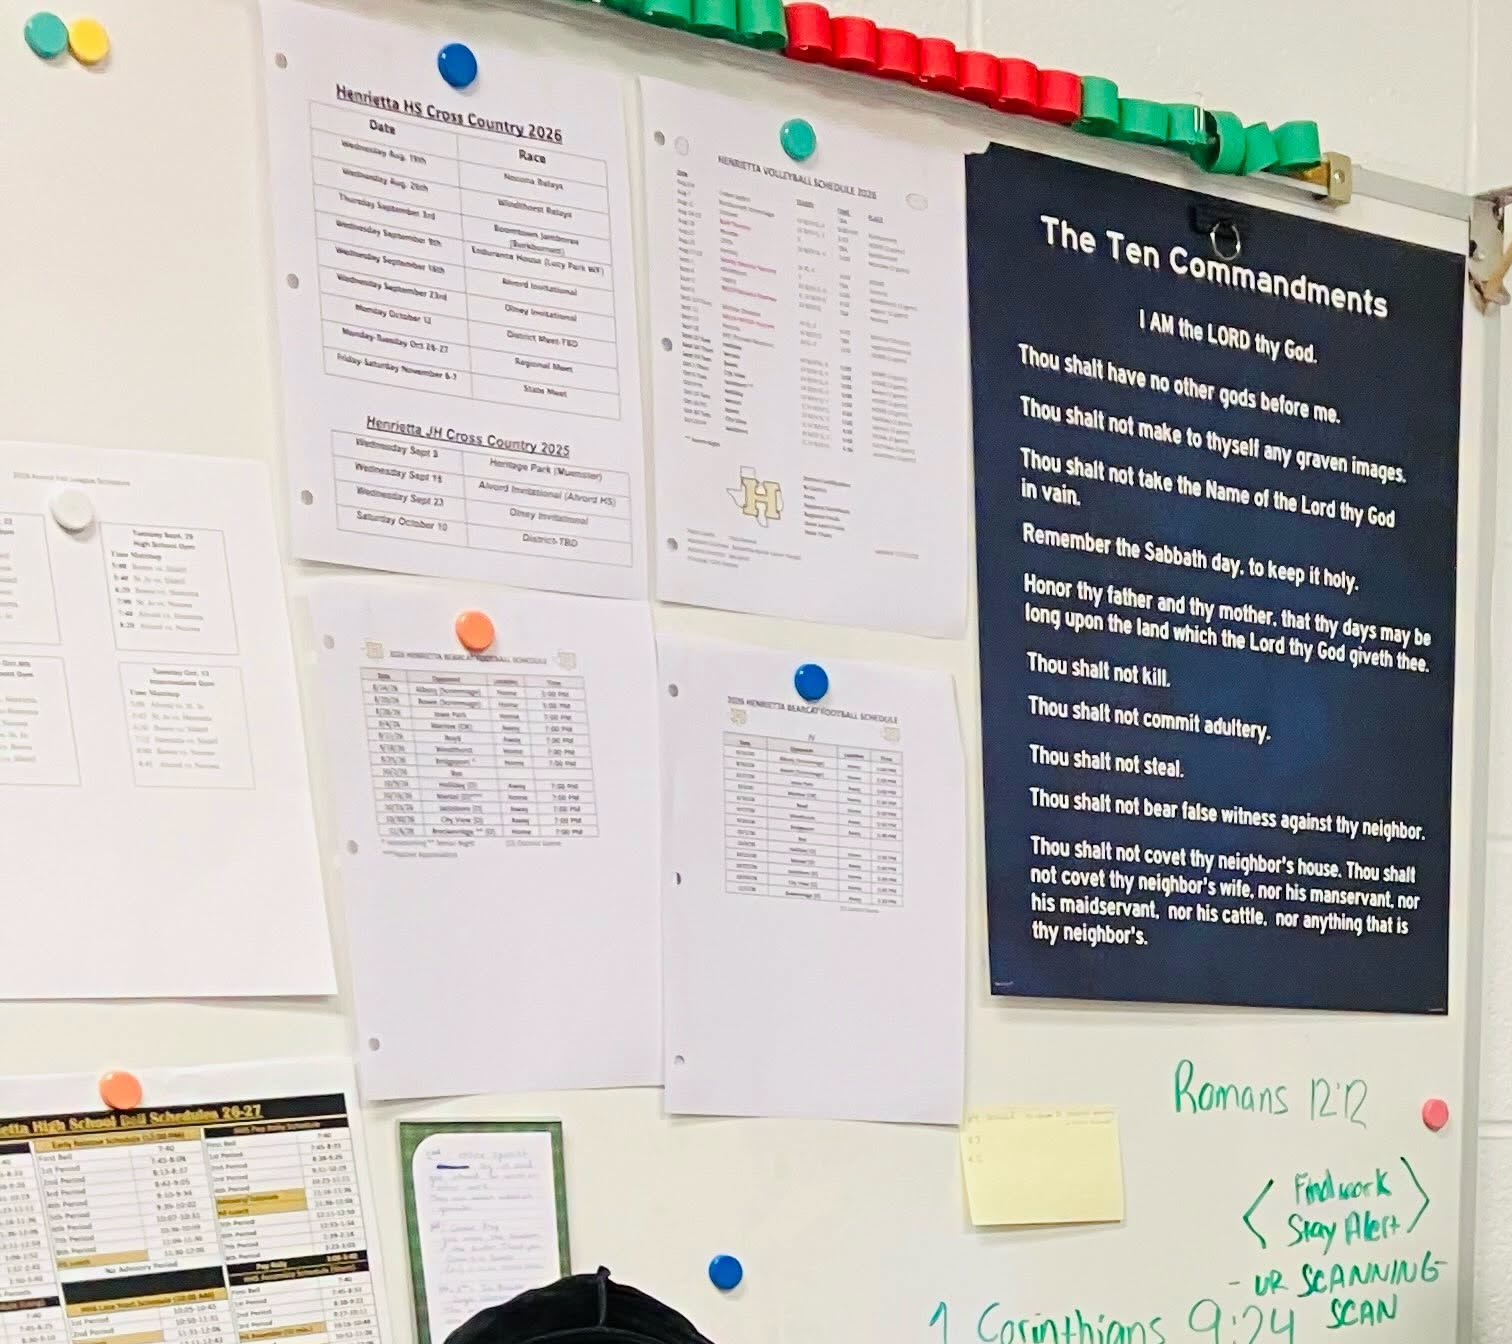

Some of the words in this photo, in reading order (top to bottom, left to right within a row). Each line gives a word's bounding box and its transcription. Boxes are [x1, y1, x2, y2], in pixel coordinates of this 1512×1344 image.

[335, 83, 401, 114] Henrietta
[403, 100, 424, 116] HS
[426, 104, 464, 125] Cross
[467, 113, 525, 137] Country
[528, 123, 564, 143] 2026
[369, 119, 396, 135] Date
[518, 149, 547, 164] Race
[1040, 215, 1096, 254] The
[1106, 230, 1160, 269] Ten
[1169, 247, 1388, 318] Commandments
[1140, 308, 1145, 329] I
[1150, 312, 1174, 336] AM
[1178, 317, 1203, 341] the
[1208, 323, 1251, 350] LORD
[1254, 333, 1281, 362] thy
[1284, 339, 1318, 364] God.
[1018, 343, 1060, 371] Thou
[1064, 354, 1104, 380] shalt
[1108, 361, 1146, 388] have
[1150, 374, 1170, 392] no
[1174, 376, 1215, 400] other
[1219, 387, 1257, 410] gods
[1260, 391, 1309, 418] before
[1314, 405, 1341, 424] me.
[366, 415, 424, 438] Henrietta
[425, 426, 444, 440] JH
[446, 428, 483, 446] Cross
[486, 435, 538, 454] Country
[541, 441, 571, 457] 2025
[1020, 395, 1061, 422] Thou
[1066, 405, 1105, 431] shalt
[1108, 416, 1134, 437] not
[1138, 422, 1182, 445] make
[1186, 427, 1202, 448] to
[1206, 430, 1260, 459] thyself
[1264, 444, 1292, 469] any
[1296, 450, 1348, 473] graven
[1352, 456, 1406, 485] images.
[1020, 447, 1062, 473] Thou
[1066, 456, 1105, 481] shalt
[1108, 466, 1134, 486] not
[1138, 468, 1173, 492] take
[1176, 475, 1202, 497] the
[1206, 479, 1250, 504] Name
[1254, 488, 1270, 508] of
[1273, 490, 1298, 512] the
[1301, 494, 1336, 518] Lord
[1340, 502, 1364, 528] thy
[1368, 506, 1395, 528] God
[1021, 477, 1038, 500] in
[1041, 484, 1081, 506] vain.
[1022, 522, 1112, 554] Remember
[1115, 536, 1141, 559] the
[1144, 541, 1207, 569] Sabbath
[1248, 557, 1264, 577] to
[1268, 560, 1305, 588] keep
[1309, 565, 1320, 586] it
[1324, 568, 1359, 596] holy.
[1026, 651, 1067, 675] Thou
[1072, 658, 1110, 680] shalt
[1114, 665, 1139, 684] not
[1142, 666, 1171, 688] kill.
[1028, 695, 1068, 718] Thou
[1072, 701, 1111, 723] shalt
[1114, 708, 1140, 726] not
[1143, 712, 1200, 733] commit
[1204, 717, 1271, 745] adultery.
[1029, 744, 1069, 766] Thou
[1073, 750, 1112, 771] shalt
[1115, 755, 1140, 774] not
[1144, 756, 1184, 778] steal.
[1029, 787, 1069, 809] Thou
[1073, 792, 1111, 813] shalt
[1115, 796, 1140, 816] not
[1144, 798, 1178, 818] bear
[1182, 800, 1218, 822] false
[1221, 806, 1277, 828] witness
[1280, 812, 1332, 834] against
[1336, 815, 1360, 840] thy
[1362, 819, 1426, 842] neighbor.
[1173, 1058, 1290, 1115] Romans
[1308, 1076, 1369, 1130] 12:12
[32, 1116, 66, 1135] High
[69, 1112, 117, 1132] School
[1287, 1212, 1338, 1256] Stay
[1344, 1210, 1401, 1246] Alert
[1326, 1293, 1398, 1329] SCAN
